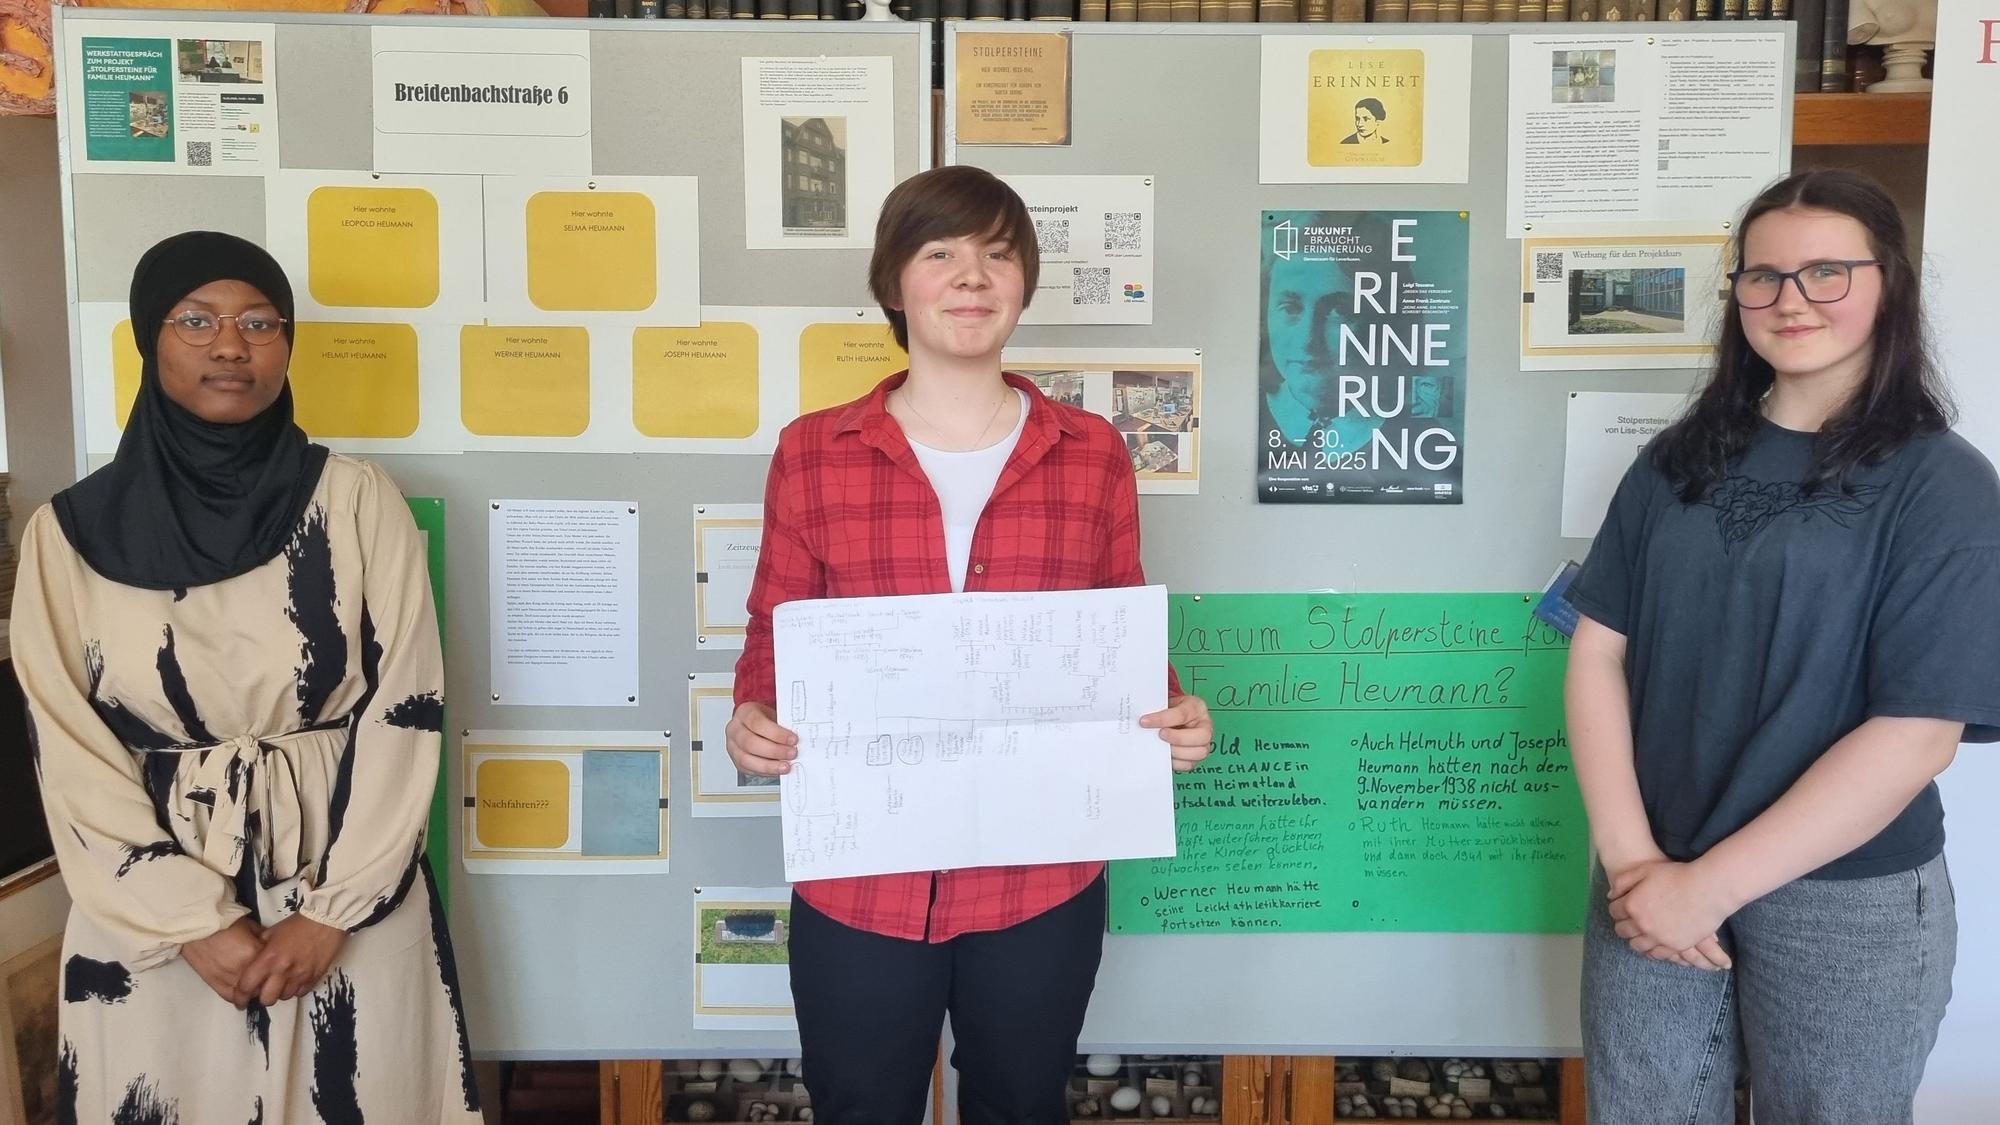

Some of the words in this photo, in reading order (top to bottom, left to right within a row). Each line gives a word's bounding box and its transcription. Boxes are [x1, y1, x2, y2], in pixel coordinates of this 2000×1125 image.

[86, 50, 163, 58] WERKSTATTGESPRÄCH
[973, 47, 1043, 58] STOLPERSTEINE
[144, 65, 158, 74] FÜR
[1349, 61, 1385, 69] LISE
[1313, 75, 1420, 88] ERINNERT
[395, 83, 553, 106] Breidenbachstraße
[557, 86, 569, 105] 6
[1026, 205, 1078, 215] rsteinprojekt
[377, 220, 413, 228] HEUMANN
[564, 224, 587, 232] SELMA
[588, 224, 625, 232] HEUMANN
[1304, 227, 1353, 235] ZUKUNFT
[1310, 236, 1360, 244] BRAUCHT
[1391, 219, 1418, 262] E
[1304, 245, 1373, 254] ERINNERUNG
[1573, 250, 1607, 260] Werbung
[1609, 250, 1620, 258] für
[1621, 250, 1637, 258] den
[1639, 250, 1682, 259] Projektkurs
[1353, 271, 1398, 314] RI
[334, 337, 349, 345] Hier
[349, 337, 376, 345] wohnte
[505, 336, 520, 344] Hier
[521, 336, 548, 345] wohnte
[691, 339, 718, 347] wohnte
[843, 341, 857, 349] Hier
[858, 341, 885, 349] wohnte
[1339, 324, 1450, 366] NNE
[322, 351, 349, 360] HELMUT
[350, 351, 387, 360] HEUMANN
[494, 351, 523, 359] WERNER
[524, 351, 561, 359] HEUMANN
[664, 351, 690, 359] JOSEPH
[691, 351, 727, 359] HEUMANN
[836, 355, 854, 363] RUTH
[855, 355, 891, 363] HEUMANN
[1338, 375, 1405, 419] RU
[1617, 416, 1670, 425] Stolpersteine
[1620, 426, 1657, 435] Lise-Sch
[1268, 430, 1287, 448] 8.
[1313, 430, 1345, 448] 30.
[1372, 427, 1457, 471] NG
[1268, 451, 1307, 470] MAI
[1314, 451, 1366, 470] 2025
[727, 543, 760, 552] Zeitzeug
[1307, 605, 1503, 658] Stolpersteine
[1185, 664, 1320, 707] Familie
[1338, 661, 1515, 707] Heumann?
[1209, 733, 1241, 756] old
[1255, 738, 1310, 751] Heumann
[1359, 732, 1394, 752] Auch
[1400, 730, 1465, 752] Helmuth
[1471, 731, 1505, 750] und
[1507, 729, 1567, 760] Joseph
[1228, 761, 1293, 775] CHANCE
[1295, 761, 1309, 772] in
[1358, 757, 1419, 774] Heumann
[1428, 755, 1481, 775] hätten
[1490, 757, 1528, 775] nach
[1536, 758, 1568, 773] dem
[1176, 782, 1206, 791] nem
[1215, 776, 1296, 791] Heimatland
[1480, 777, 1518, 794] nicht
[482, 799, 549, 809] Nachfahren???
[1174, 795, 1236, 810] utschland
[1241, 793, 1327, 808] weiterzuleben.
[1357, 796, 1425, 811] wandern
[1438, 797, 1503, 811] müssen.
[1178, 821, 1198, 834] ma
[1205, 820, 1255, 831] Heumann
[1259, 814, 1296, 831] hätte
[1299, 814, 1318, 828] ihr
[1360, 816, 1412, 833] Ruth
[1421, 817, 1470, 831] Heumann
[1178, 834, 1203, 849] häft
[1363, 837, 1382, 849] mit
[1390, 836, 1417, 847] ihrer
[1426, 835, 1472, 848] Mutter
[1182, 850, 1208, 861] ihre
[1215, 846, 1259, 858] Kinder
[1267, 841, 1325, 861] glücklich
[1364, 851, 1382, 863] und
[1389, 850, 1416, 861] dann
[1423, 850, 1449, 861] doch
[1453, 850, 1482, 862] 1941
[1511, 850, 1527, 861] ihr
[1226, 859, 1263, 872] sehen
[1154, 886, 1217, 900] Werner
[1227, 883, 1283, 895] Heumann
[1286, 880, 1320, 892] hätte
[1155, 905, 1185, 918] seine
[1161, 918, 1221, 932] fortsetzen
[1230, 916, 1282, 928] können.
